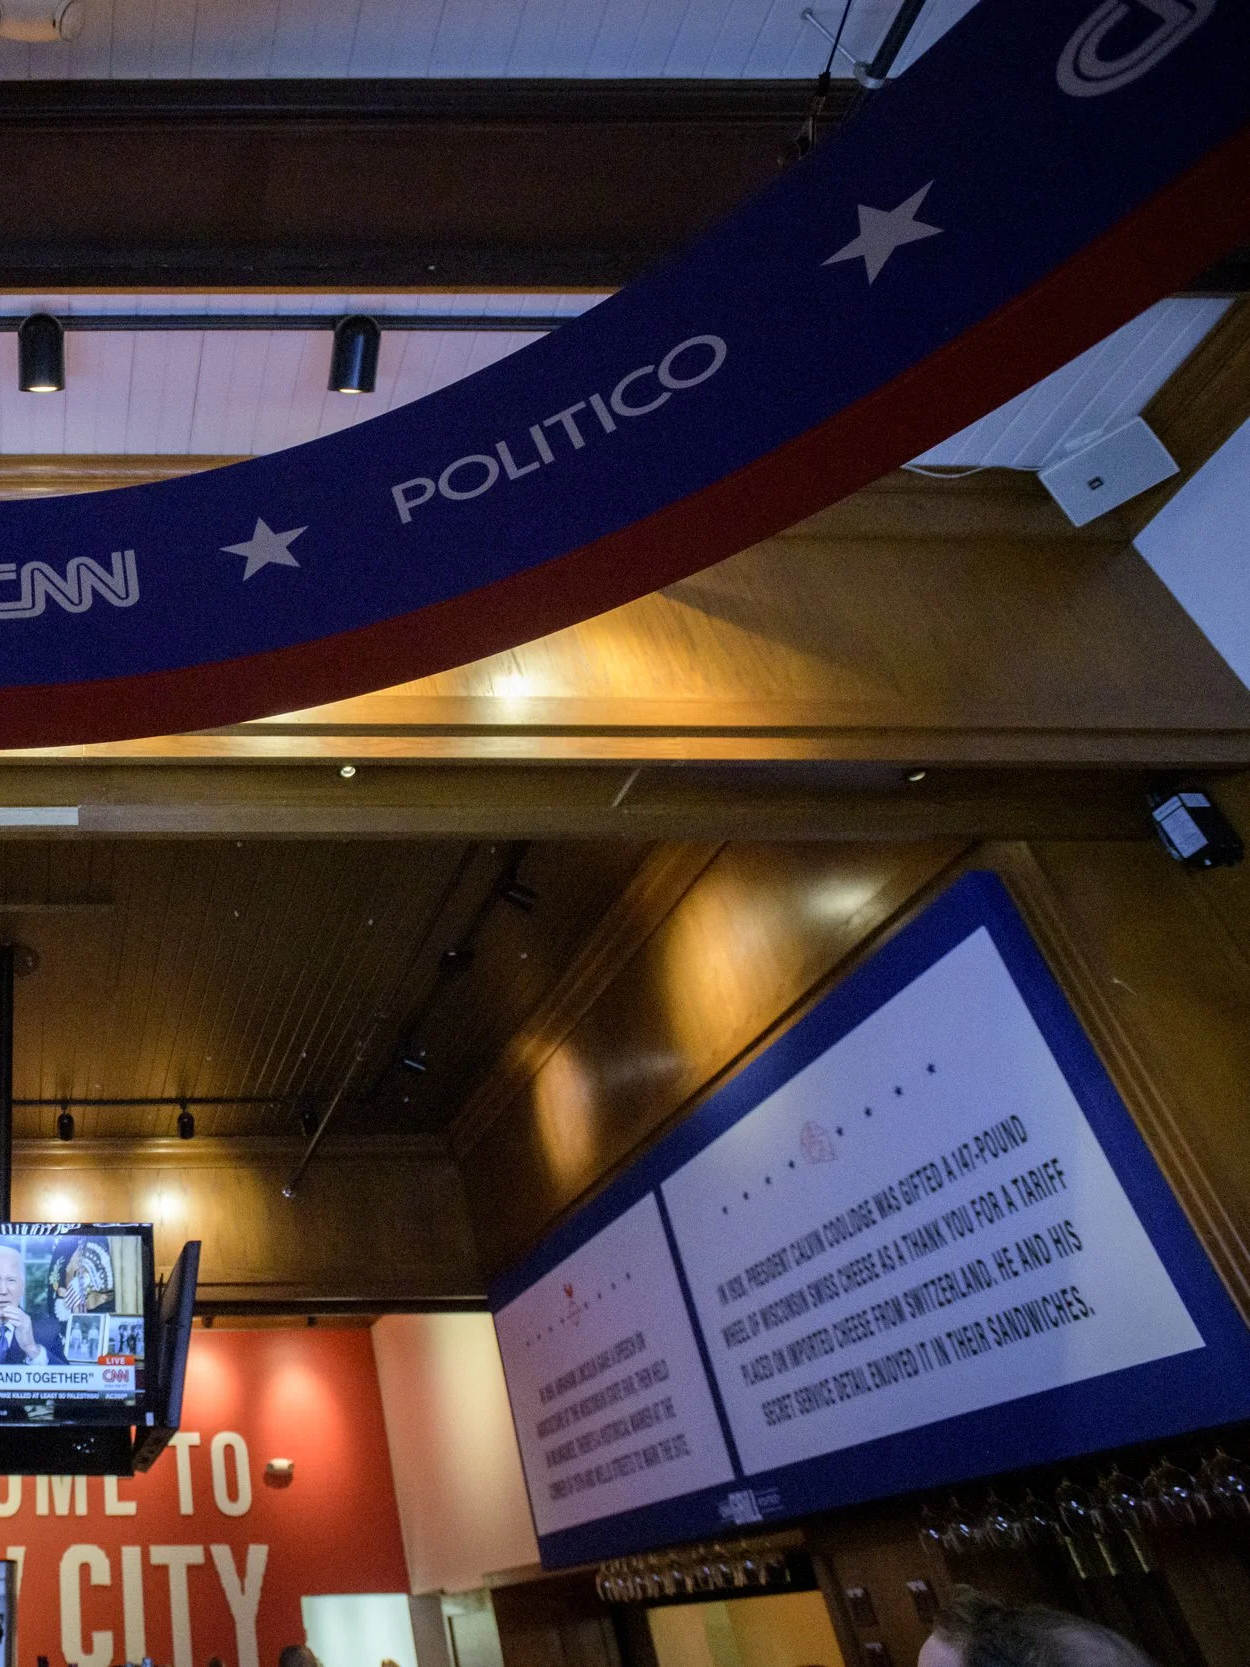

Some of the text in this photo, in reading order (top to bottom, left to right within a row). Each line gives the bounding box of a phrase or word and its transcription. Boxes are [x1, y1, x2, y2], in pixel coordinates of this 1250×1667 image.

[391, 335, 728, 525] POLITICO
[872, 1185, 902, 1220] WAS
[898, 1162, 944, 1206] GIFTED
[941, 1156, 957, 1183] A
[951, 1114, 1028, 1176] 147-POUND
[806, 1273, 840, 1308] SWISS
[837, 1253, 881, 1293] CHEESE
[876, 1245, 896, 1274] AS
[893, 1240, 907, 1266] A
[900, 1219, 948, 1260] THANK
[941, 1205, 975, 1241] YOU
[969, 1191, 1005, 1228] FOR
[1000, 1185, 1019, 1214] A
[1010, 1157, 1067, 1207] TARIFF
[832, 1310, 875, 1349] CHEESE
[870, 1296, 907, 1332] FROM
[903, 1259, 998, 1319] SWITZERLAND.
[992, 1247, 1020, 1281] HE
[1015, 1233, 1052, 1272] AND
[1047, 1220, 1083, 1258] HIS
[26, 1372, 94, 1384] TOGETHER"
[102, 1368, 129, 1383] CNN
[106, 1357, 126, 1365] LIVE
[866, 1347, 920, 1389] ENJOYED
[915, 1341, 934, 1372] IT
[930, 1336, 951, 1367] IN
[945, 1321, 992, 1360] THEIR
[986, 1285, 1095, 1347] SANDWICHES.
[168, 1430, 253, 1517] TO
[59, 1543, 269, 1667] CITY
